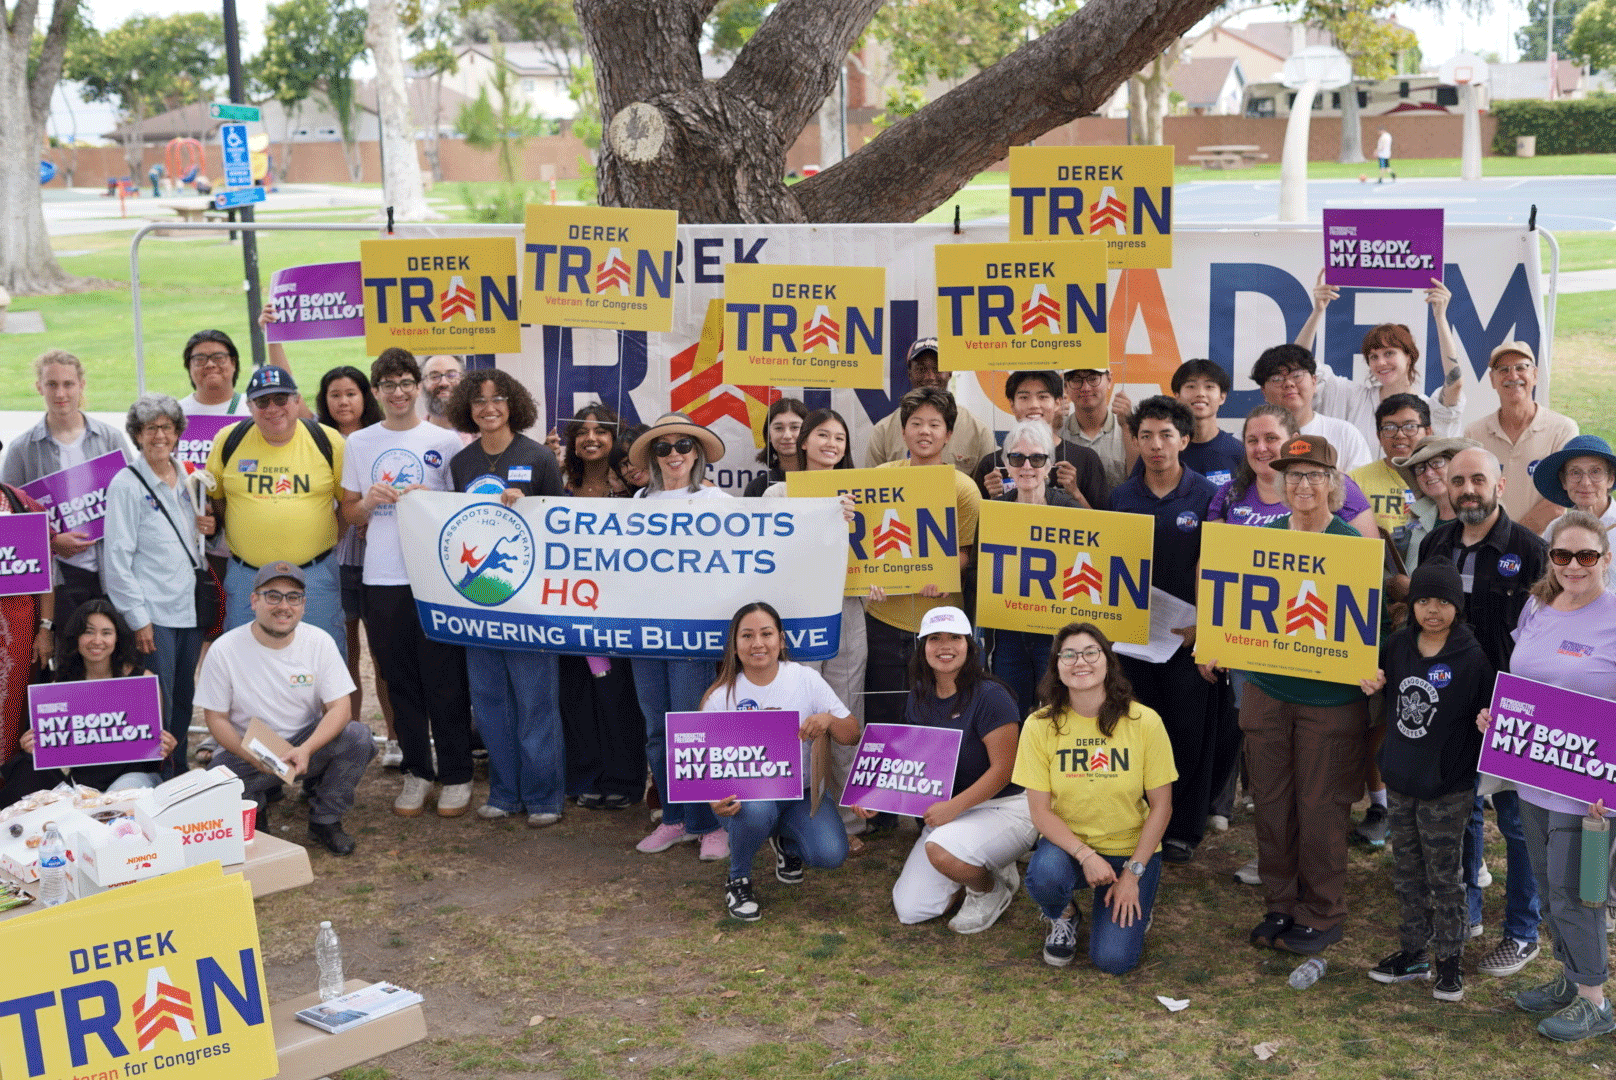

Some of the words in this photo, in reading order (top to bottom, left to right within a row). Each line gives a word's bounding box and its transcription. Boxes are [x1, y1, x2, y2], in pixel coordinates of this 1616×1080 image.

[1058, 166, 1123, 181] DEREK
[1011, 186, 1172, 236] TRAN
[568, 225, 630, 242] DEREK
[1107, 240, 1146, 250] ongress
[1330, 239, 1358, 254] MY
[1360, 240, 1411, 254] BODY.
[408, 256, 470, 272] DEREK
[526, 243, 672, 298] TRAN
[986, 262, 1056, 279] DEREK
[1330, 254, 1358, 268] MY
[1360, 254, 1435, 270] BALLOT.
[273, 295, 298, 309] MY
[300, 292, 347, 308] BODY.
[364, 275, 518, 324] TRAN
[772, 283, 836, 300] DEREK
[545, 296, 583, 306] Veteran
[586, 296, 600, 307] for
[602, 298, 648, 311] Congress
[938, 282, 1108, 336] TRAN
[389, 326, 429, 336] Veteran
[432, 326, 446, 336] for
[449, 325, 496, 336] Congress
[726, 303, 883, 355] TRAN
[965, 340, 1008, 350] Veteran
[1011, 338, 1027, 349] for
[1030, 338, 1082, 350] Congress
[749, 355, 788, 366] Veteran
[792, 356, 807, 366] for
[810, 357, 858, 368] Congress
[244, 474, 310, 495] TRAN
[544, 506, 795, 538] GRASSROOTS
[848, 506, 958, 560] RAN
[444, 508, 490, 561] GRASSROOTS
[495, 510, 530, 566] DEMOCRATS
[1030, 526, 1100, 548] DEREK
[544, 542, 776, 574] DEMOCRATS
[864, 564, 880, 574] for
[883, 562, 934, 574] Congress
[1253, 550, 1326, 574] DEREK
[981, 543, 1150, 610] TRAN
[540, 578, 600, 612] HQ
[1005, 600, 1047, 613] Veteran
[1051, 604, 1067, 614] for
[1070, 606, 1122, 621] Congress
[1201, 569, 1380, 646] TRAN
[432, 610, 566, 646] POWERING
[572, 624, 632, 650] THE
[642, 626, 724, 651] BLUE
[785, 627, 828, 648] VE
[1224, 632, 1269, 648] Veteran
[1273, 639, 1290, 650] for
[1294, 642, 1348, 658] Congress
[1428, 671, 1451, 680] TRAN
[38, 716, 70, 732] MY
[72, 712, 127, 730] BODY.
[40, 731, 70, 748] MY
[73, 724, 152, 745] BALLOT.
[1076, 738, 1107, 746] DEREK
[1496, 714, 1532, 737] MY
[1533, 724, 1597, 757] BODY.
[674, 748, 706, 762] MY
[709, 746, 766, 762] BODY.
[1056, 747, 1130, 772] TRAN
[1491, 731, 1528, 756] MY
[1530, 742, 1616, 783] BALLOT.
[675, 764, 706, 779] MY
[710, 761, 792, 778] BALLOT.
[856, 756, 882, 772] MY
[880, 758, 925, 776] BODY.
[852, 771, 878, 787] MY
[876, 774, 944, 796] BALLOT.
[70, 930, 178, 975] DEREK
[0, 948, 265, 1078] TRAN
[124, 1061, 148, 1078] for
[154, 1042, 231, 1070] Congress
